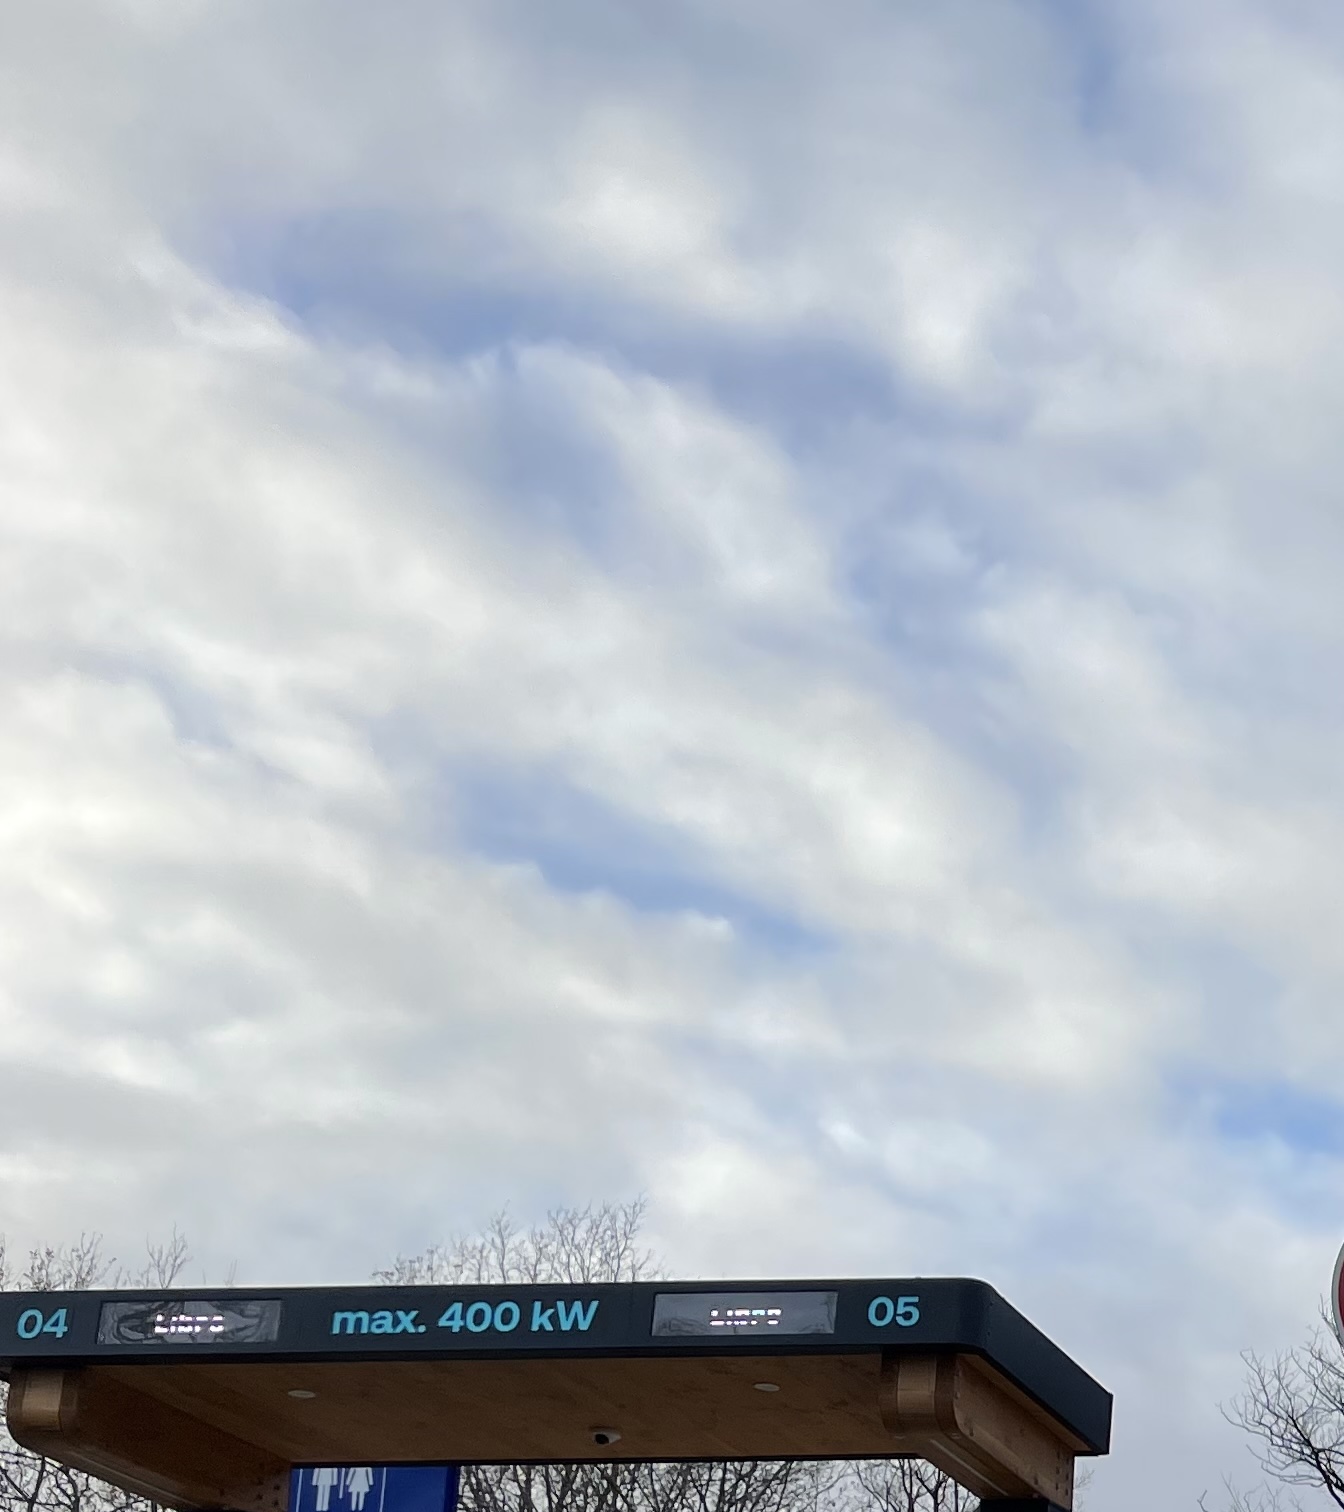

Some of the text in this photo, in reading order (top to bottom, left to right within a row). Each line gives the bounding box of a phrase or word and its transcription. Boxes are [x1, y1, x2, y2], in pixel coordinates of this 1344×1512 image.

[17, 1308, 68, 1339] 04
[332, 1300, 599, 1334] max. 400 kW
[867, 1296, 920, 1327] 05
